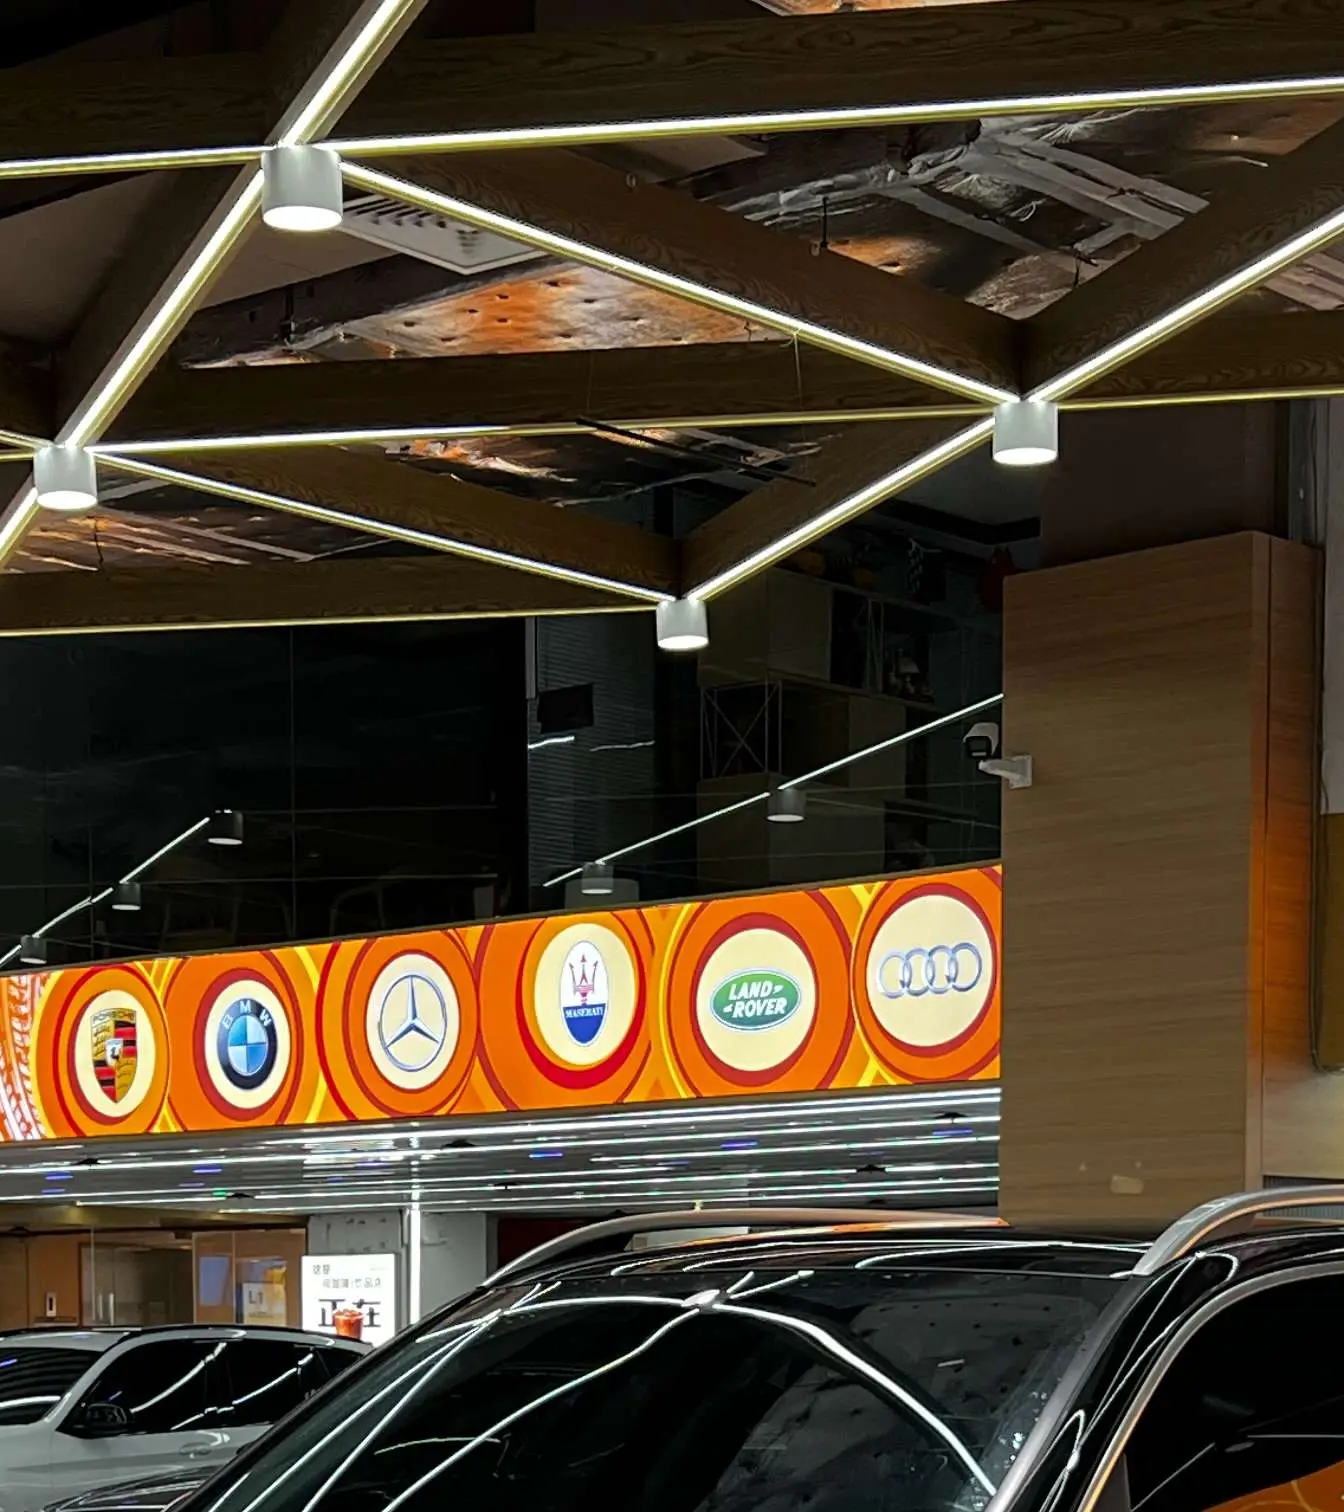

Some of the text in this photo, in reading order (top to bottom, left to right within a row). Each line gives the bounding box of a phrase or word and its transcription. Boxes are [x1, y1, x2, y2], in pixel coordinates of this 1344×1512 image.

[727, 979, 774, 1002] LAND
[220, 1000, 273, 1029] BMW
[564, 1006, 604, 1019] MASERATI
[731, 997, 787, 1020] ROVER
